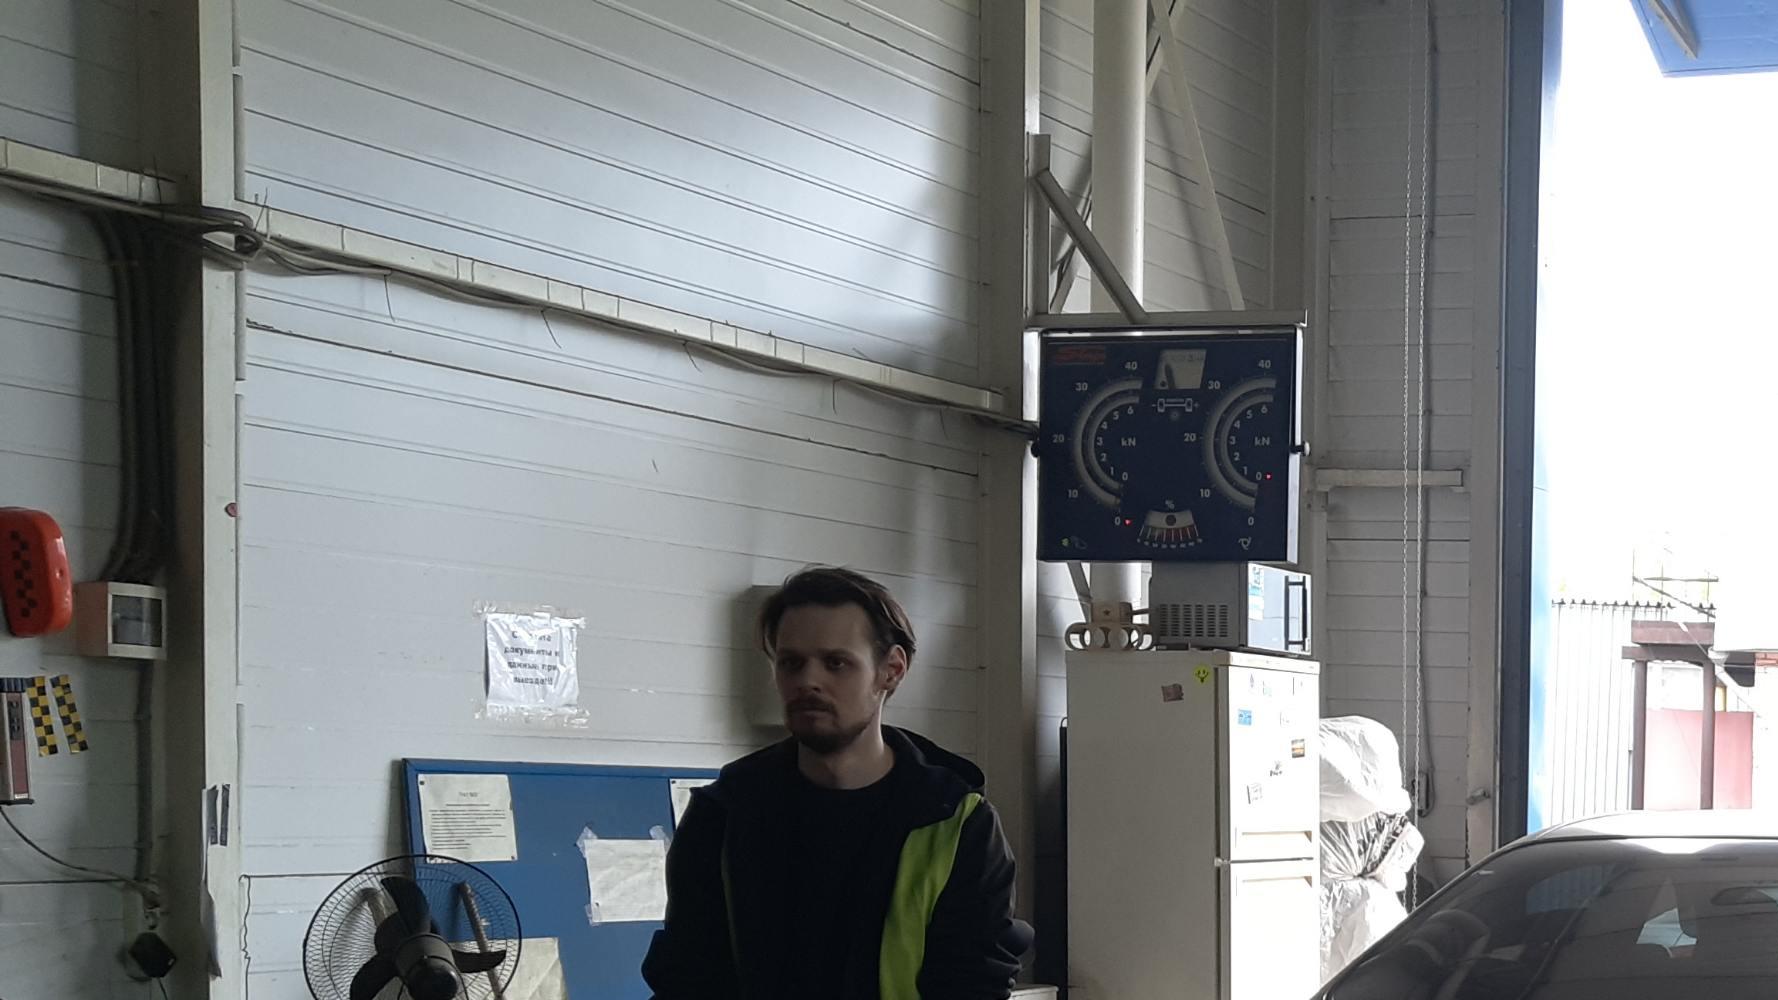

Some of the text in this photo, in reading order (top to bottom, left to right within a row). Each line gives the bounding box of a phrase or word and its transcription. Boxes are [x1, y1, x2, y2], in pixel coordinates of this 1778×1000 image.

[1125, 361, 1137, 370] 40
[1258, 360, 1271, 369] 40
[1075, 382, 1088, 391] 30
[1208, 380, 1220, 389] 30
[1053, 434, 1064, 443] 20
[1121, 437, 1136, 447] kN
[1184, 433, 1196, 442] 20
[1254, 437, 1270, 446] kN
[1068, 489, 1078, 498] 10
[1200, 488, 1210, 498] 10
